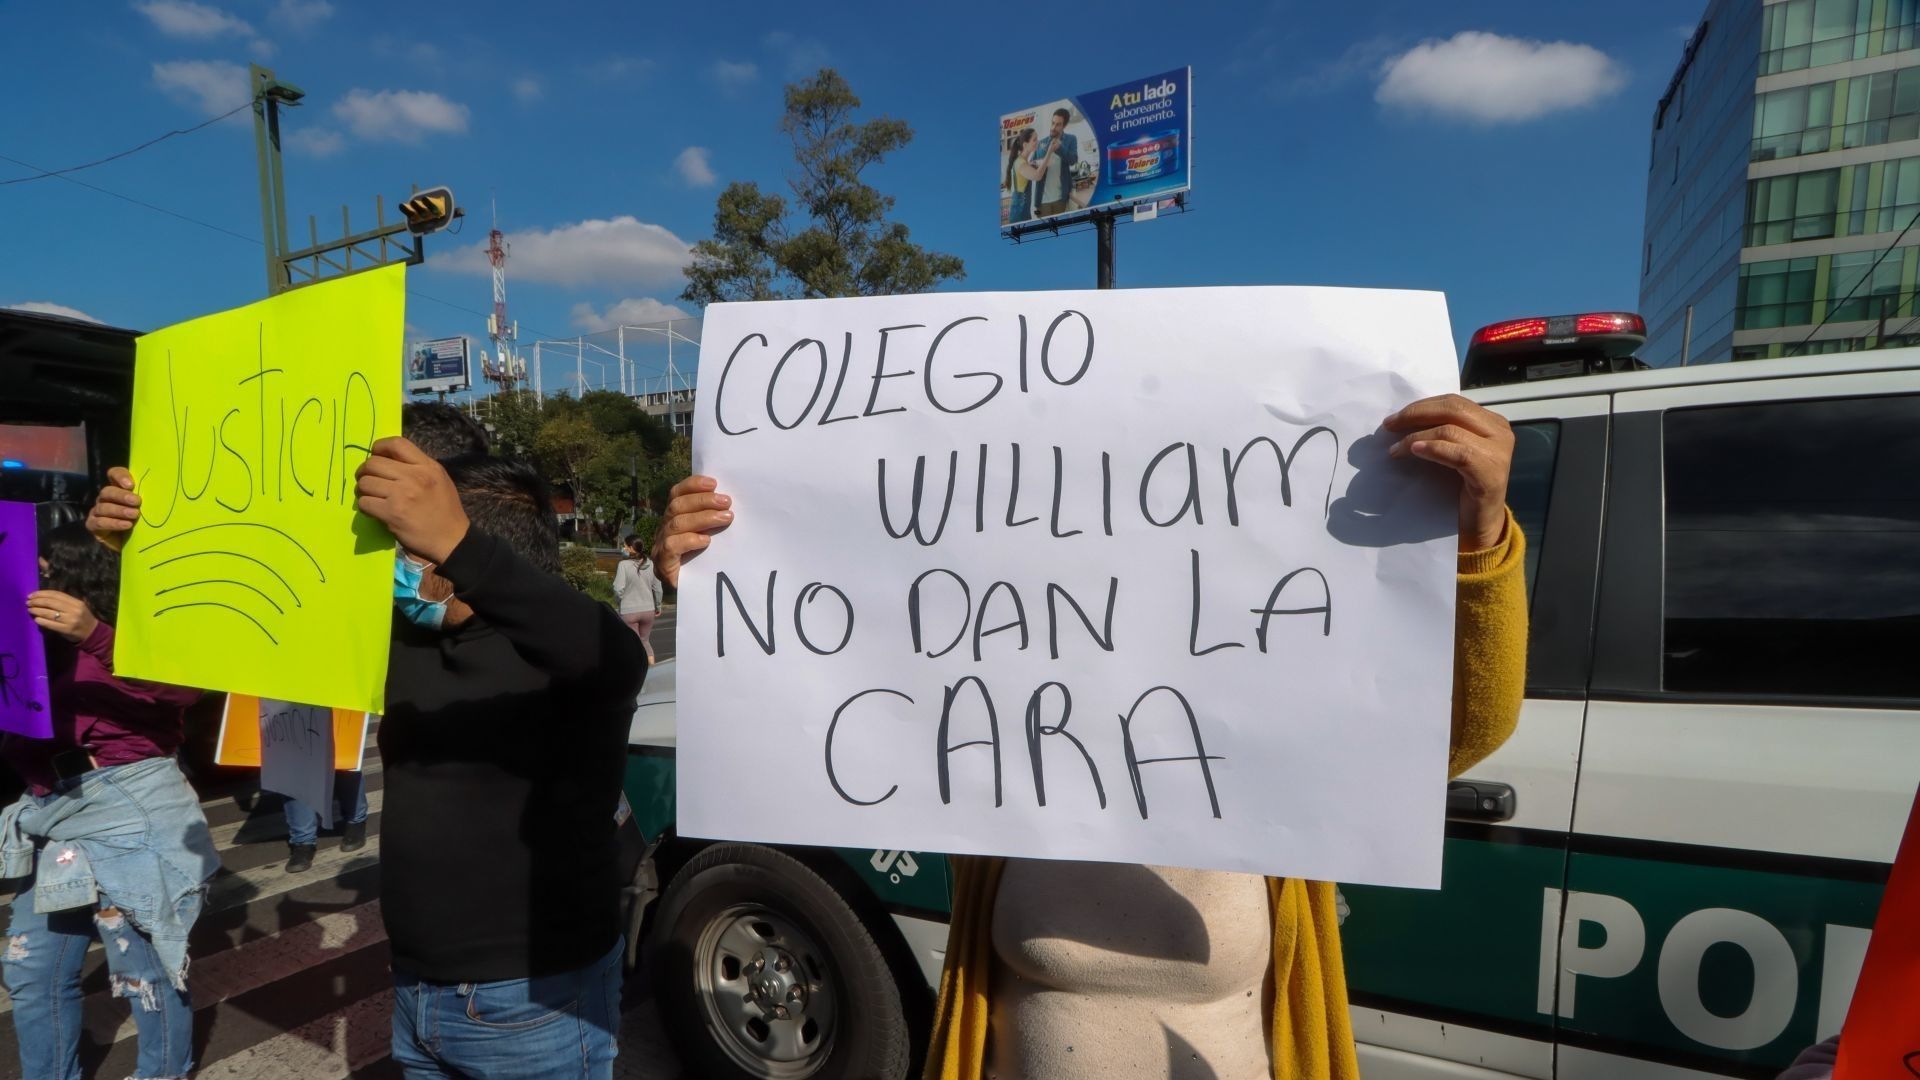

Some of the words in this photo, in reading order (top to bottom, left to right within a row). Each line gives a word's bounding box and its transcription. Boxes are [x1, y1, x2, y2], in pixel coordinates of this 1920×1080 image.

[1110, 121, 1120, 132] el
[1122, 110, 1176, 130] momento.
[1114, 98, 1172, 121] saboreando
[1144, 80, 1176, 101] lado
[715, 310, 1095, 436] COLEGIO
[715, 570, 855, 658] NO
[908, 568, 1118, 661] DAN
[1189, 549, 1332, 656] LA
[825, 675, 1226, 820] CARA
